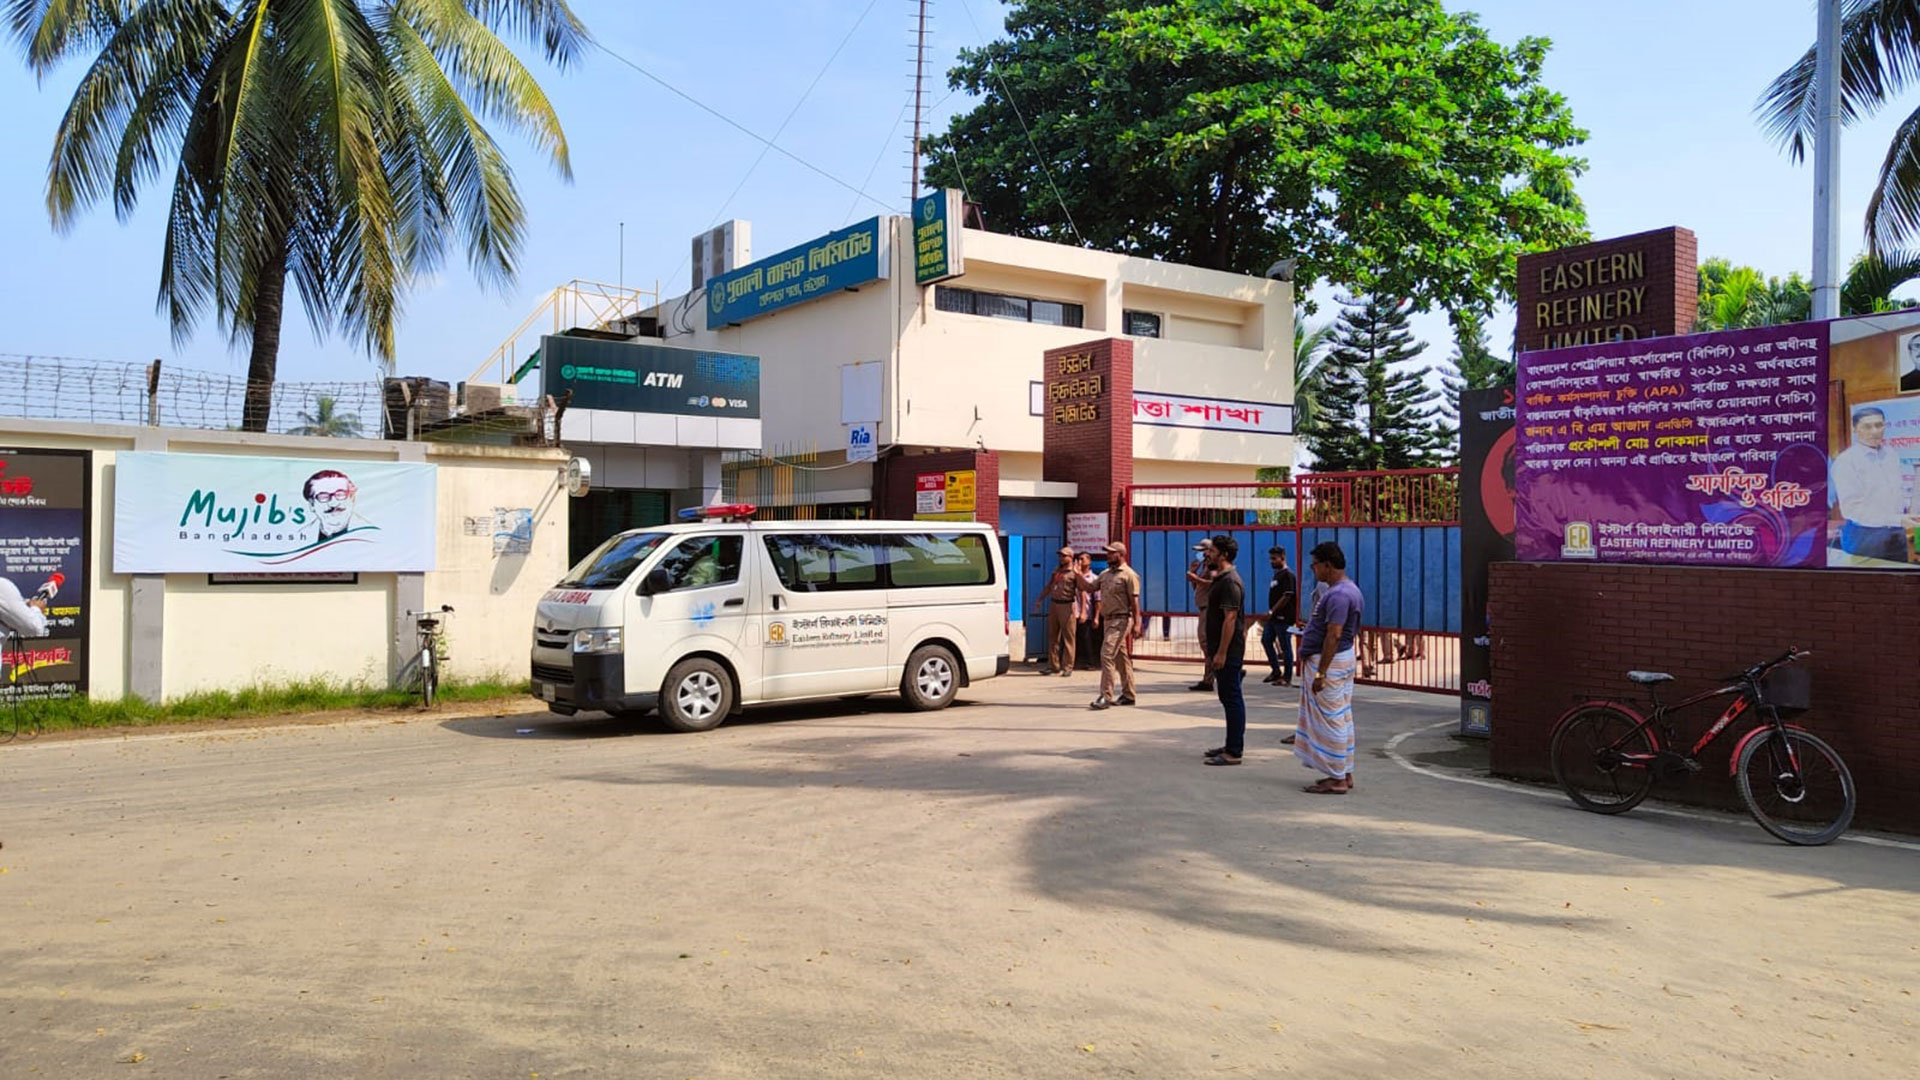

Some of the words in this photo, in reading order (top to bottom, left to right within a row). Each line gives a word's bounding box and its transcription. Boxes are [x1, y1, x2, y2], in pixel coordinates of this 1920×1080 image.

[809, 231, 872, 272] লিমিটেড
[1540, 250, 1644, 294] EASTERN
[1536, 286, 1645, 328] REFINERY
[1526, 361, 1568, 376] বাংলাদেশ
[1687, 344, 1735, 362] (বিপিসি)
[1739, 346, 1749, 354] ও
[1754, 343, 1772, 354] এর
[643, 371, 684, 389] ATM
[1605, 373, 1630, 385] মধ্যে
[1690, 363, 1747, 377] ২০২১-২২
[1644, 384, 1685, 399] (APA)
[1736, 377, 1780, 390] দক্ষতার
[1787, 374, 1817, 386] সাথে
[728, 398, 748, 408] VISA
[1717, 395, 1771, 409] চেয়ারম্যান
[1775, 390, 1816, 408] (সচিব)
[1179, 404, 1264, 425] শাখা
[850, 426, 870, 444] Ria
[1558, 425, 1567, 435] এ
[1571, 421, 1584, 435] বি
[1588, 422, 1606, 433] এম
[1611, 420, 1651, 432] আজাদ
[1568, 436, 1620, 451] প্রকৌশলী
[1625, 438, 1649, 450] মোঃ
[1655, 435, 1709, 448] লোকমান
[1713, 436, 1730, 446] এর
[1735, 434, 1762, 444] হাতে
[1630, 453, 1647, 466] এই
[1739, 448, 1778, 461] পরিবার
[1686, 466, 1768, 495] আনন্দিত
[1740, 491, 1757, 508] ও
[1760, 481, 1812, 511] গর্বিত
[179, 489, 306, 538] Mujib's
[179, 531, 307, 542] Bangladesh
[1635, 521, 1697, 537] রিফাইনারী
[1701, 522, 1755, 537] লিমিটেড
[1600, 537, 1647, 548] EASTERN
[1650, 538, 1705, 549] REFINERY
[1708, 539, 1753, 550] LIMITED
